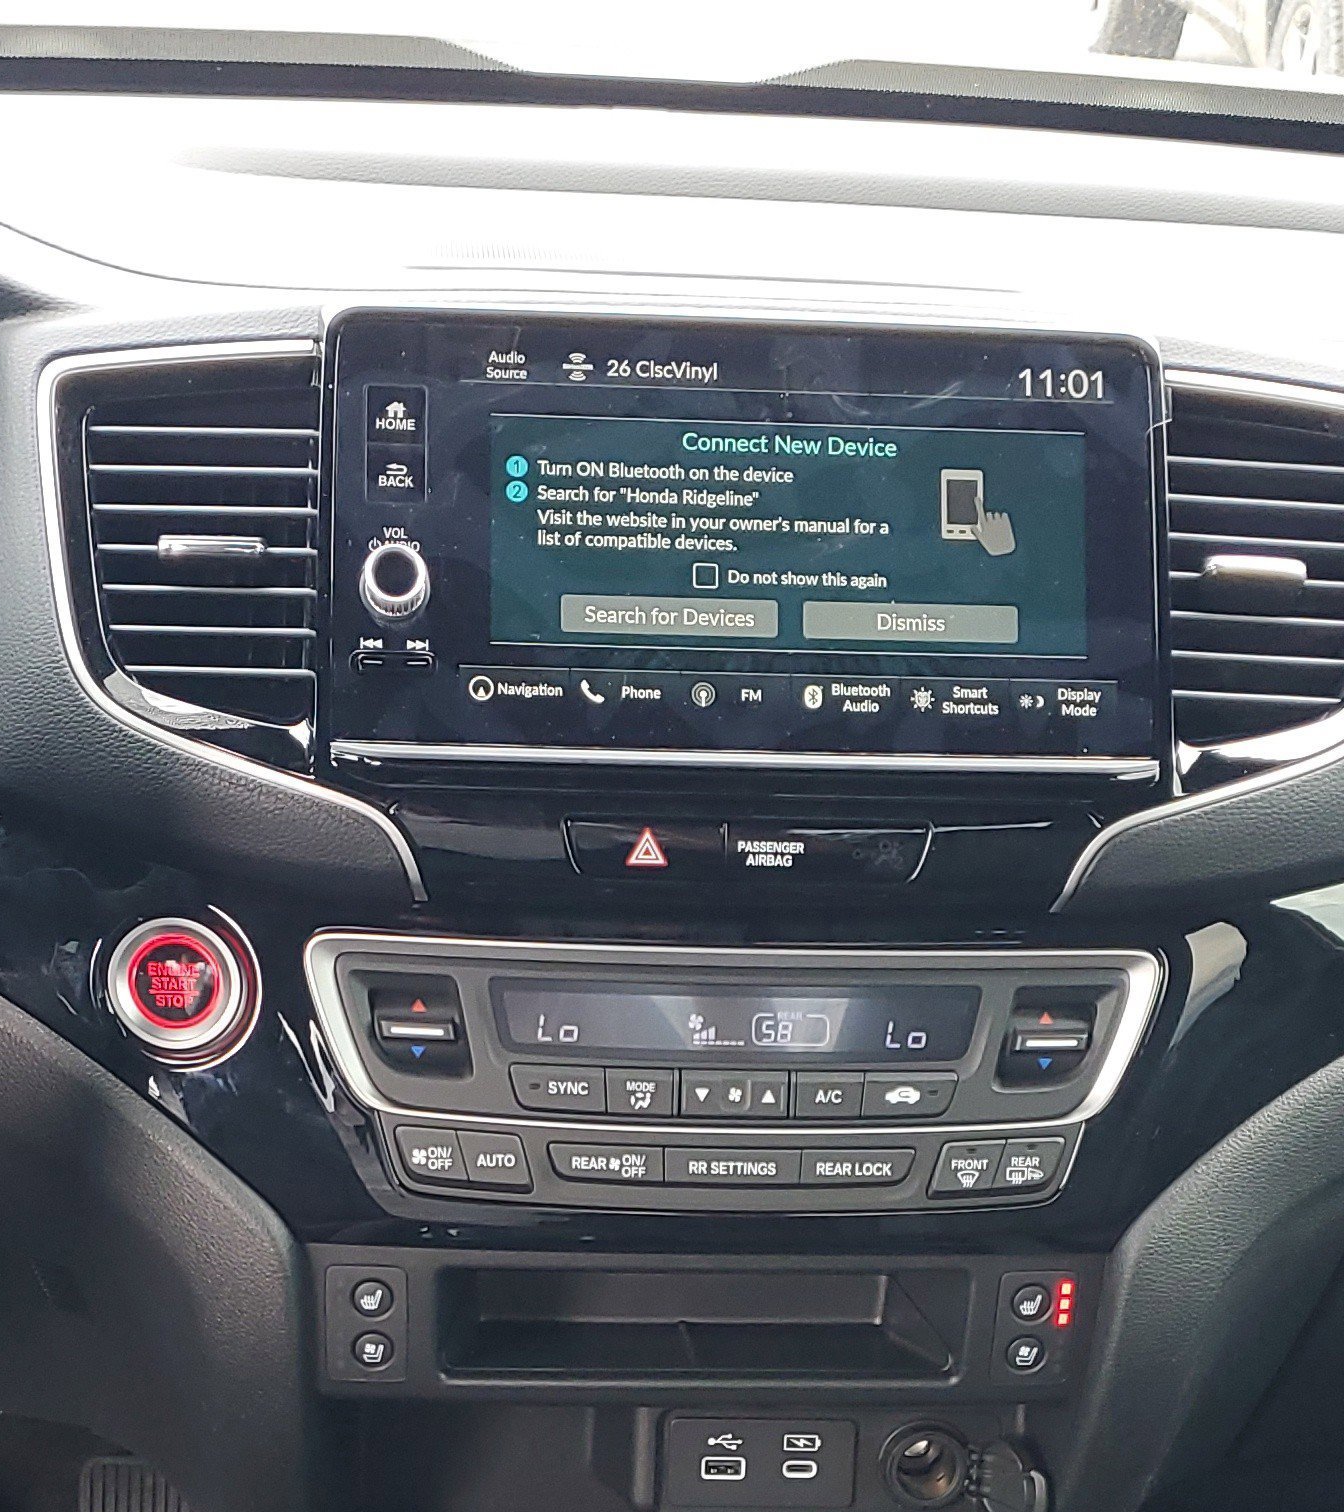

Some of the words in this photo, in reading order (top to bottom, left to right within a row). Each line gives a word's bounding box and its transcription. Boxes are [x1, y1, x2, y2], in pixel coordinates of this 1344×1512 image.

[488, 350, 526, 366] Audio
[486, 366, 528, 381] Source
[606, 360, 630, 378] 26
[636, 360, 718, 384] ClscVinyl
[1018, 368, 1104, 400] 11:01
[375, 418, 416, 432] HOME
[682, 432, 768, 454] Connect
[774, 435, 822, 456] New
[828, 436, 898, 457] Device
[537, 460, 572, 478] Turn
[576, 461, 604, 478] ON
[608, 462, 686, 480] Bluetooth
[689, 469, 710, 481] on
[712, 466, 740, 482] the
[743, 466, 794, 484] device
[378, 474, 414, 489] BACK
[537, 485, 590, 502] Search
[593, 486, 616, 502] for
[620, 487, 678, 504] "Honda
[682, 489, 760, 508] Ridgeline"
[537, 509, 573, 526] Visit
[576, 510, 602, 526] the
[606, 512, 668, 529] website
[672, 514, 686, 530] in
[690, 518, 726, 534] your
[728, 516, 790, 532] owner's
[794, 518, 850, 534] manual
[854, 518, 876, 534] for
[880, 523, 890, 534] a
[382, 526, 408, 539] VOL
[537, 530, 560, 546] list
[564, 530, 582, 547] of
[584, 532, 672, 552] compatible
[674, 534, 738, 552] devices.
[728, 570, 750, 584] Do
[753, 570, 778, 586] not
[780, 570, 818, 586] show
[822, 572, 848, 588] this
[850, 572, 888, 590] again
[584, 606, 646, 626] Search
[650, 608, 678, 626] for
[682, 608, 755, 628] Devices
[876, 612, 946, 632] Dismiss
[498, 682, 564, 698] Navigation
[621, 686, 662, 700] Phone
[741, 689, 762, 702] FM
[831, 684, 891, 698] Bluetooth
[952, 686, 988, 699] Smart
[1057, 688, 1102, 704] Display
[842, 698, 880, 714] Audio
[942, 702, 1000, 716] Shortcuts
[1060, 704, 1097, 718] Mode
[736, 840, 804, 855] PASSENGER
[745, 853, 793, 868] AIRBAG
[151, 977, 197, 990] START
[155, 994, 194, 1008] STOP
[547, 1081, 589, 1096] SYNC
[626, 1081, 656, 1094] MODE
[814, 1090, 843, 1104] A/C
[428, 1146, 453, 1160] ON/
[622, 1154, 646, 1166] ON/
[428, 1158, 453, 1172] OFF
[476, 1154, 516, 1168] AUTO
[572, 1156, 607, 1170] REAR
[950, 1158, 988, 1172] FRONT
[1010, 1155, 1040, 1168] REAR
[622, 1164, 647, 1178] OFF
[688, 1161, 708, 1176] RR
[710, 1162, 776, 1177] SETTINGS
[816, 1162, 852, 1177] REAR
[854, 1162, 892, 1178] LOCK
